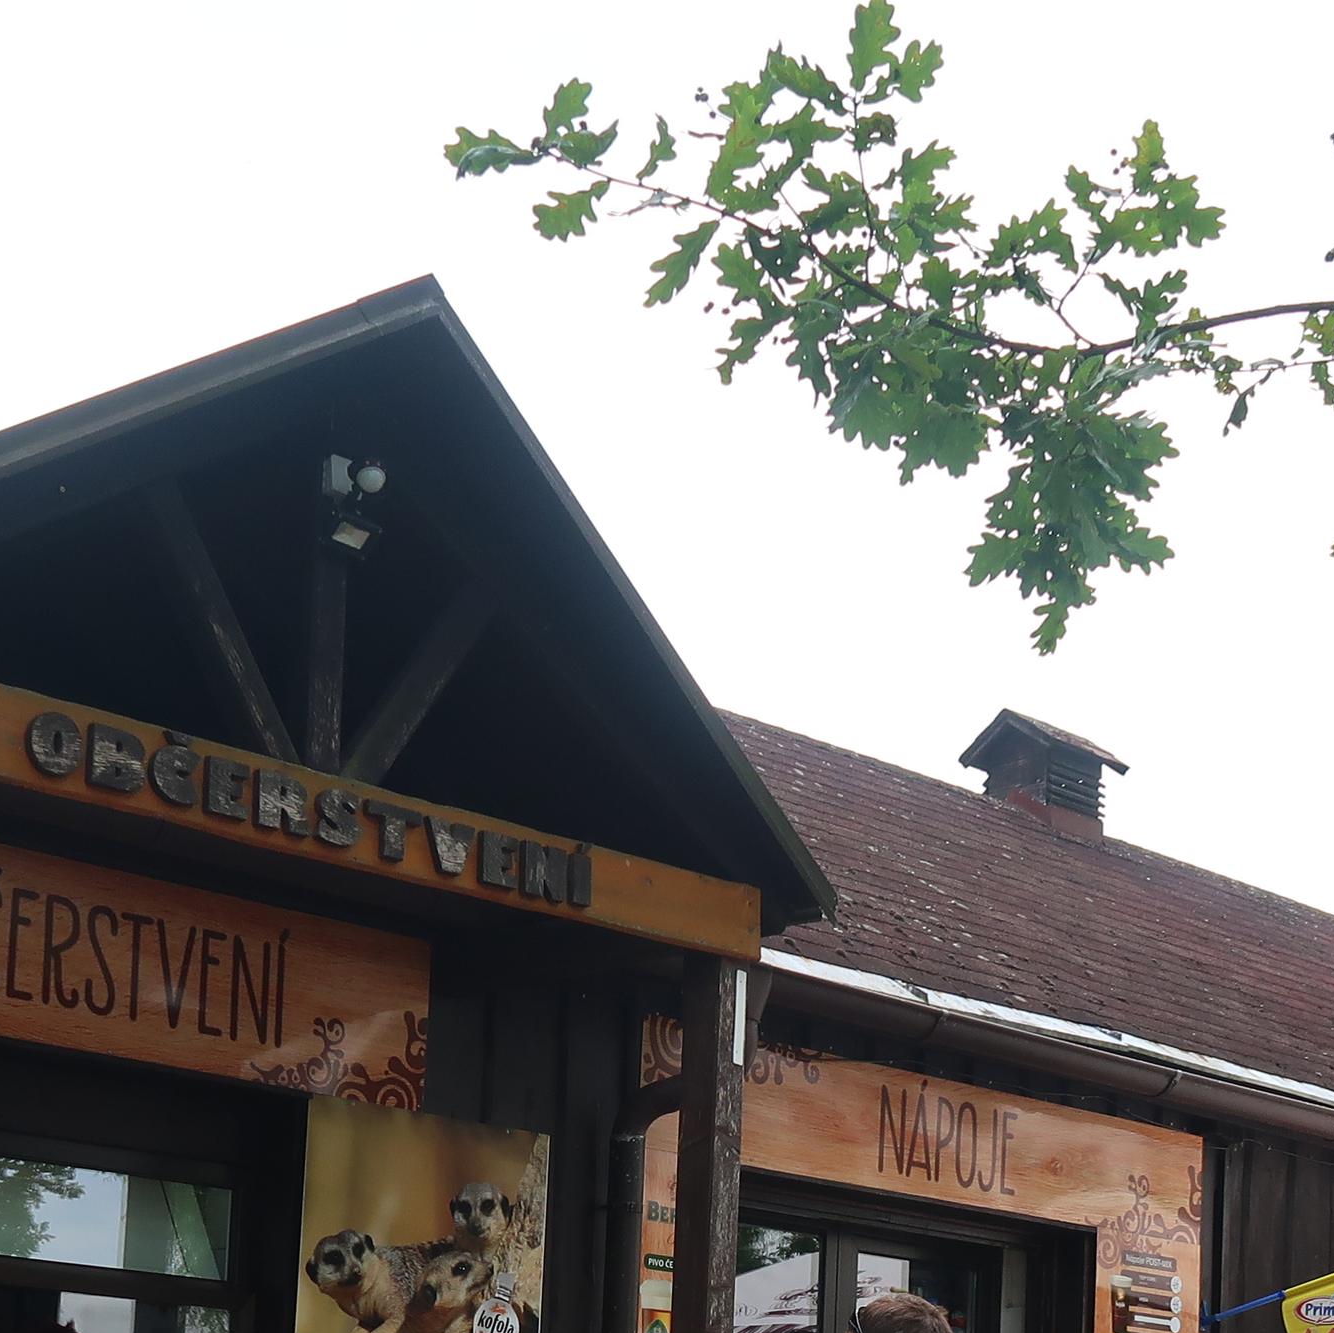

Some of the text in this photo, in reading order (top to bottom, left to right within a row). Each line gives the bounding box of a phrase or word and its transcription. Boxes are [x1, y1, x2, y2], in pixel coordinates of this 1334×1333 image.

[24, 712, 592, 908] OBČERSTVENÍ
[878, 1079, 1018, 1196] NÁPOJE
[648, 1257, 664, 1268] PIVO
